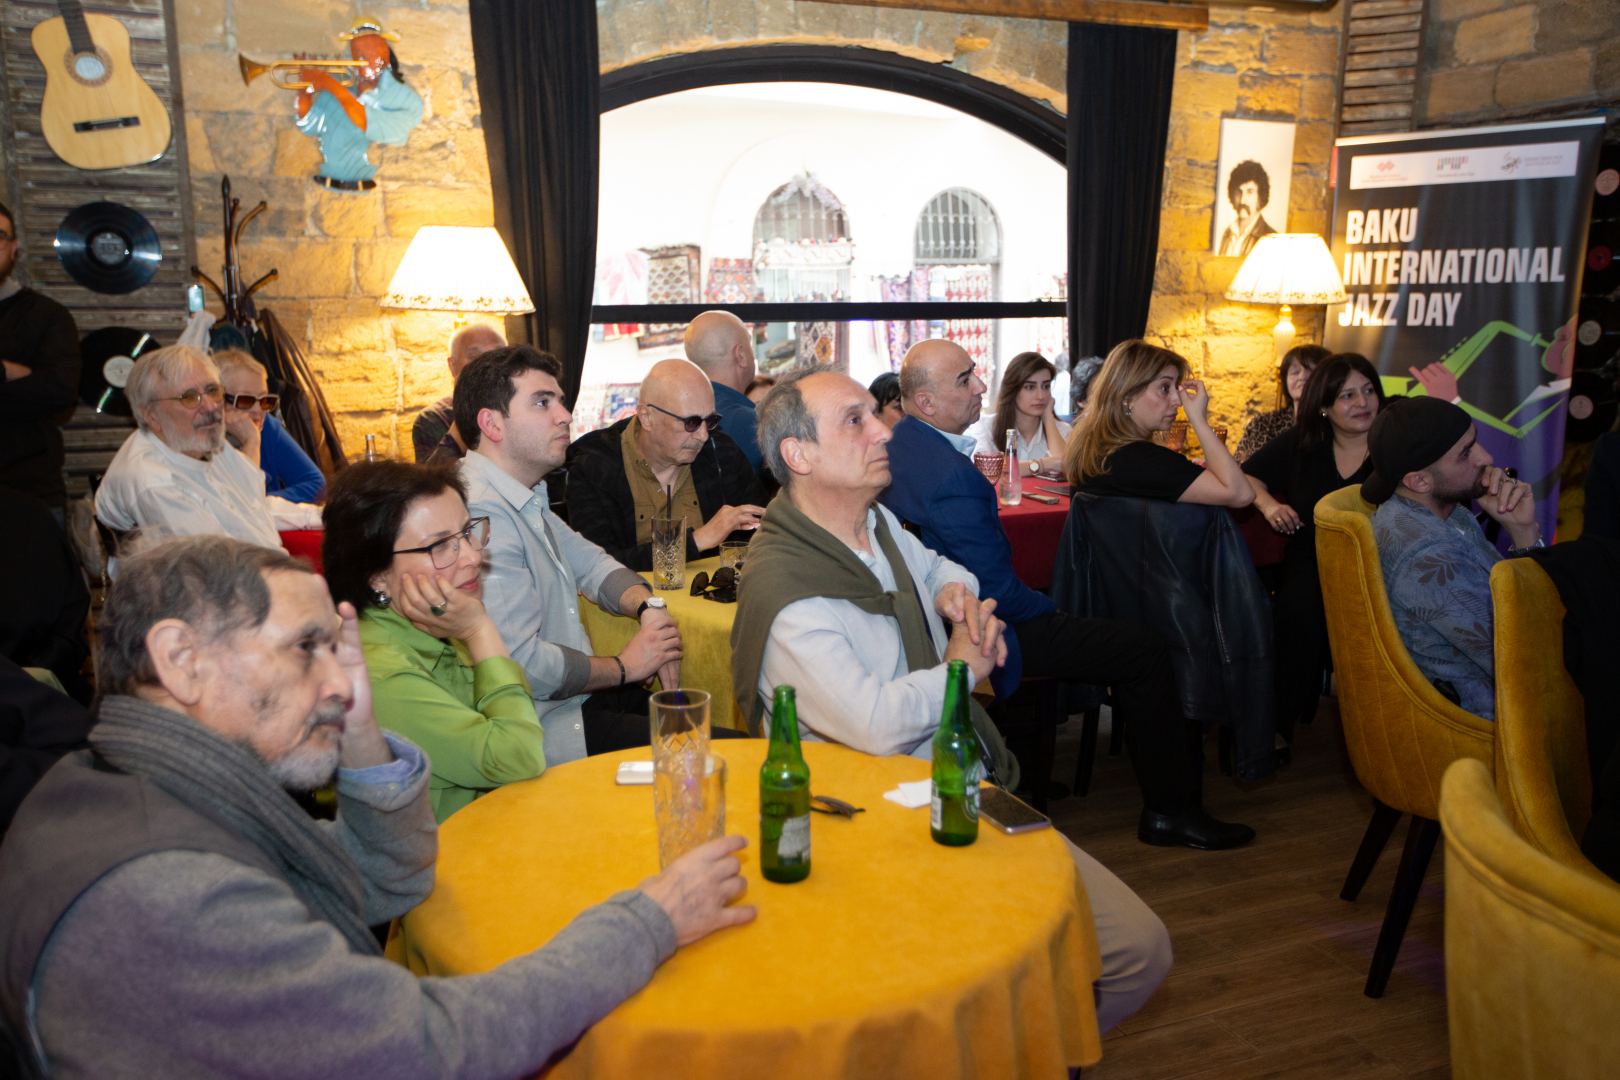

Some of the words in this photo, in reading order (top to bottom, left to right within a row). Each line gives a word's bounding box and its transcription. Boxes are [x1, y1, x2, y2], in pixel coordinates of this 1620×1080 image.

[1346, 207, 1418, 244] BAKU
[1343, 247, 1565, 285] INTERNATIONAL
[1338, 292, 1399, 327] JAZZ
[1407, 292, 1462, 327] DAY
